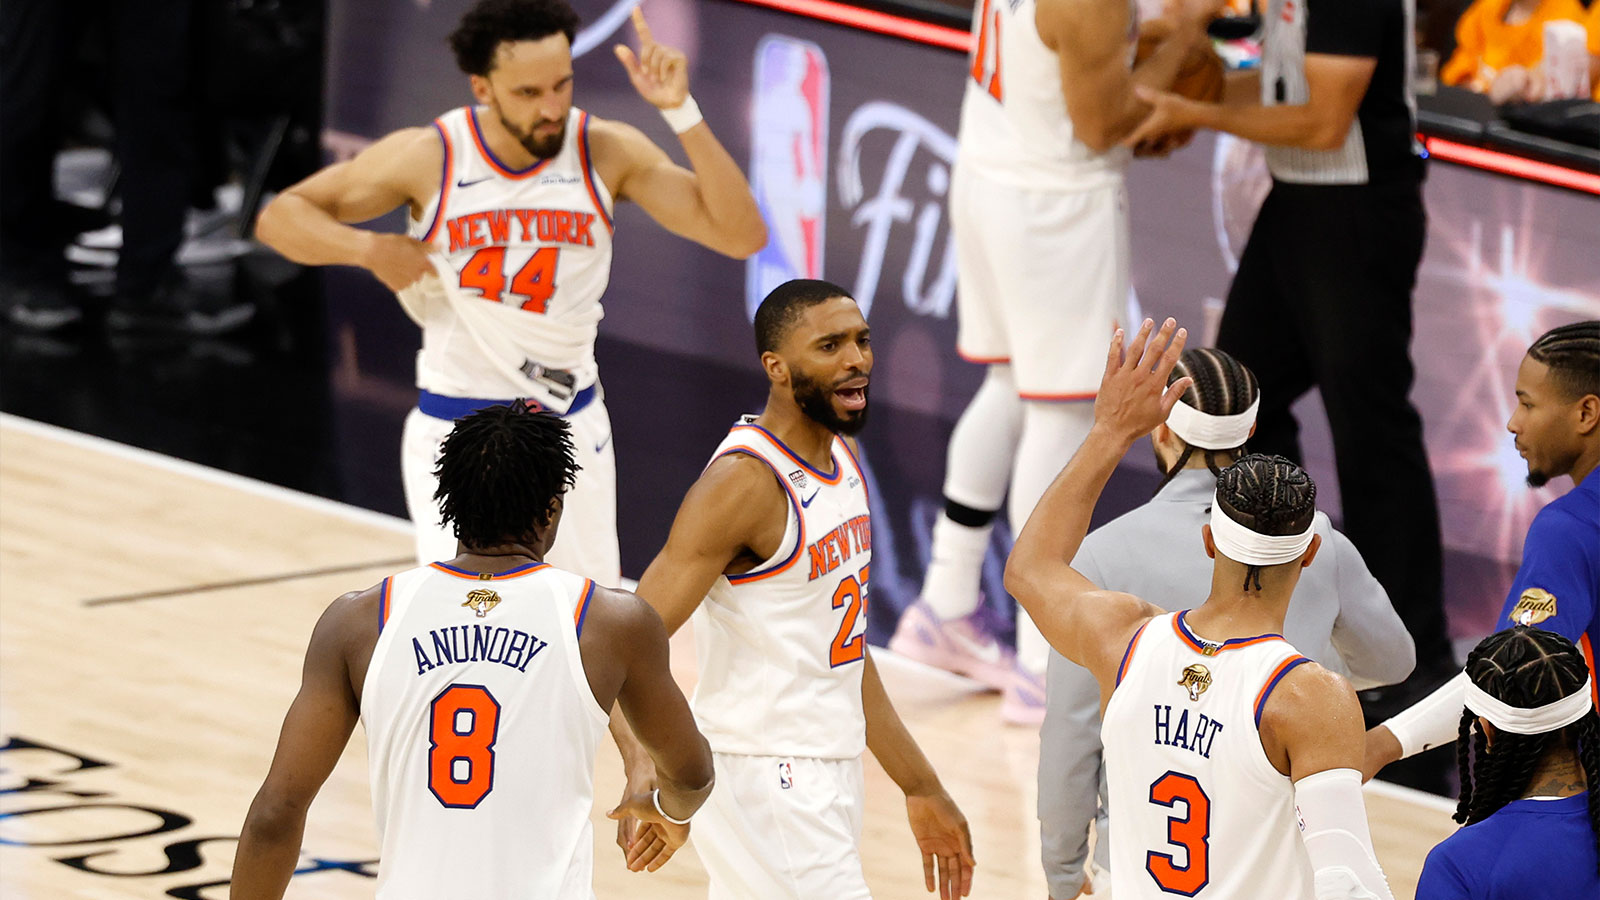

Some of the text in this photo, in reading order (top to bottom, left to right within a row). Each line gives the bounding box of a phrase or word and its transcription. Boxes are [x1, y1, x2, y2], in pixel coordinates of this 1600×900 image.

[459, 245, 562, 315] 44
[808, 525, 851, 582] NEW
[412, 624, 548, 676] ANUNOBY
[1178, 667, 1211, 686] Finals
[428, 683, 502, 810] 8
[1154, 704, 1223, 759] HART
[1146, 770, 1211, 898] 3
